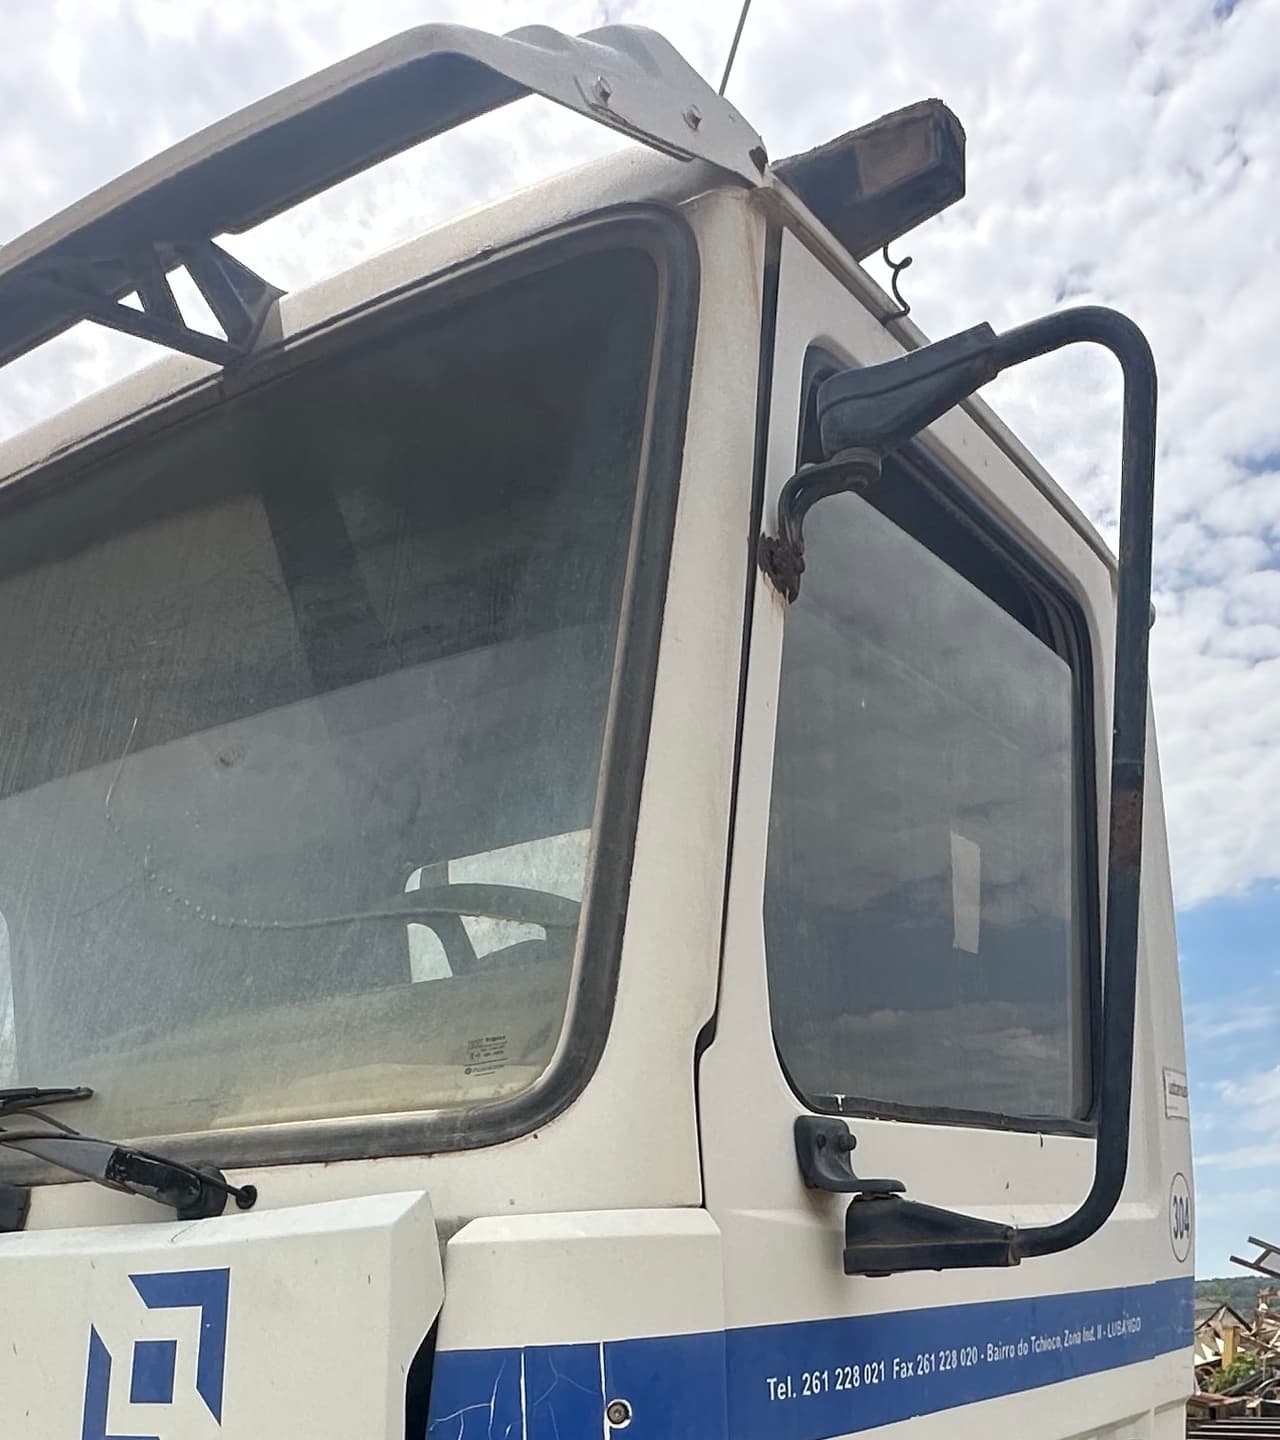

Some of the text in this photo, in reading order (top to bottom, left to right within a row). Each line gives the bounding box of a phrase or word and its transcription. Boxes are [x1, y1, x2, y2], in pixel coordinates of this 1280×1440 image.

[1172, 1195, 1190, 1240] 304
[766, 1376, 797, 1401] Tel.
[802, 1370, 830, 1396] 261
[835, 1366, 861, 1391] 228
[864, 1360, 886, 1384] 021
[892, 1358, 914, 1380] Fax
[917, 1353, 936, 1375] 261
[939, 1350, 958, 1371] 228
[960, 1346, 978, 1366] 020
[987, 1341, 1015, 1362] Bairro
[1017, 1341, 1029, 1355] do
[1063, 1329, 1082, 1348] Zona
